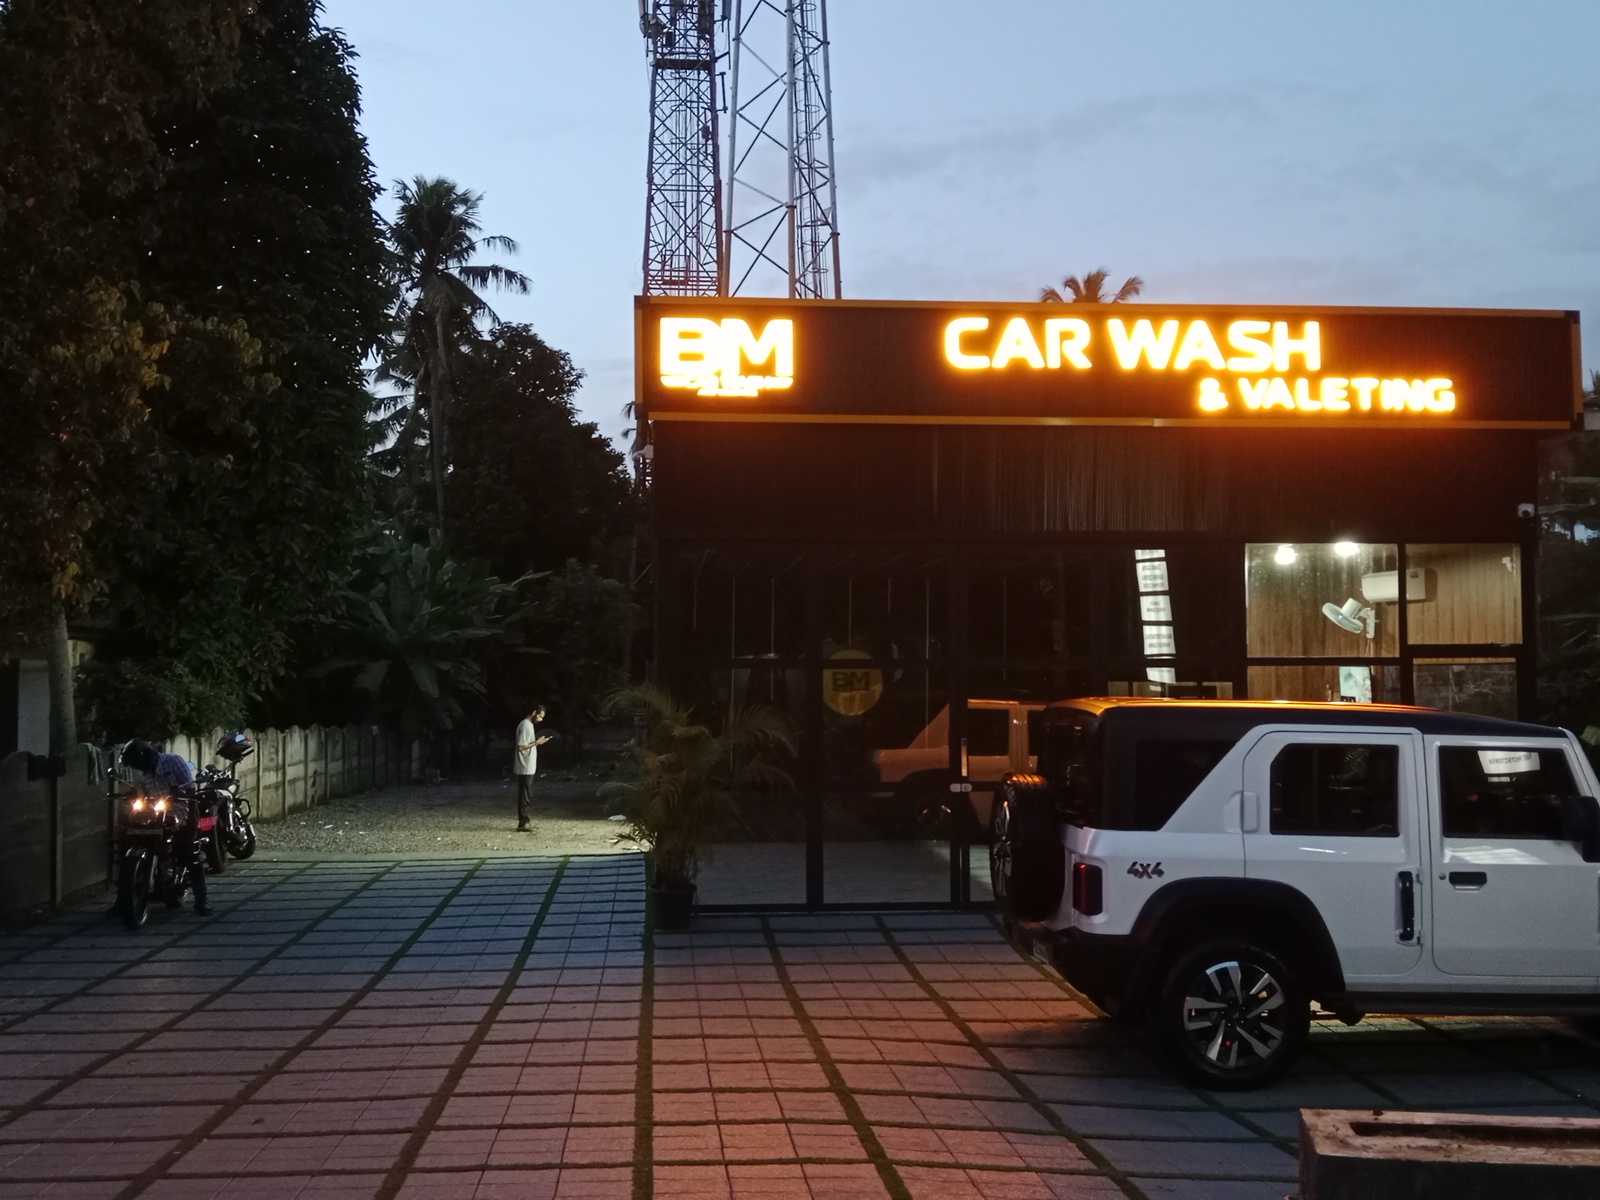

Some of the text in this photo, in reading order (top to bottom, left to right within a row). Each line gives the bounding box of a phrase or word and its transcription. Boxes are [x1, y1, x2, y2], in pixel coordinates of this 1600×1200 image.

[659, 317, 794, 377] BM
[944, 316, 1322, 372] CAR WASH
[1198, 377, 1457, 412] & VALETING
[832, 671, 870, 688] BM
